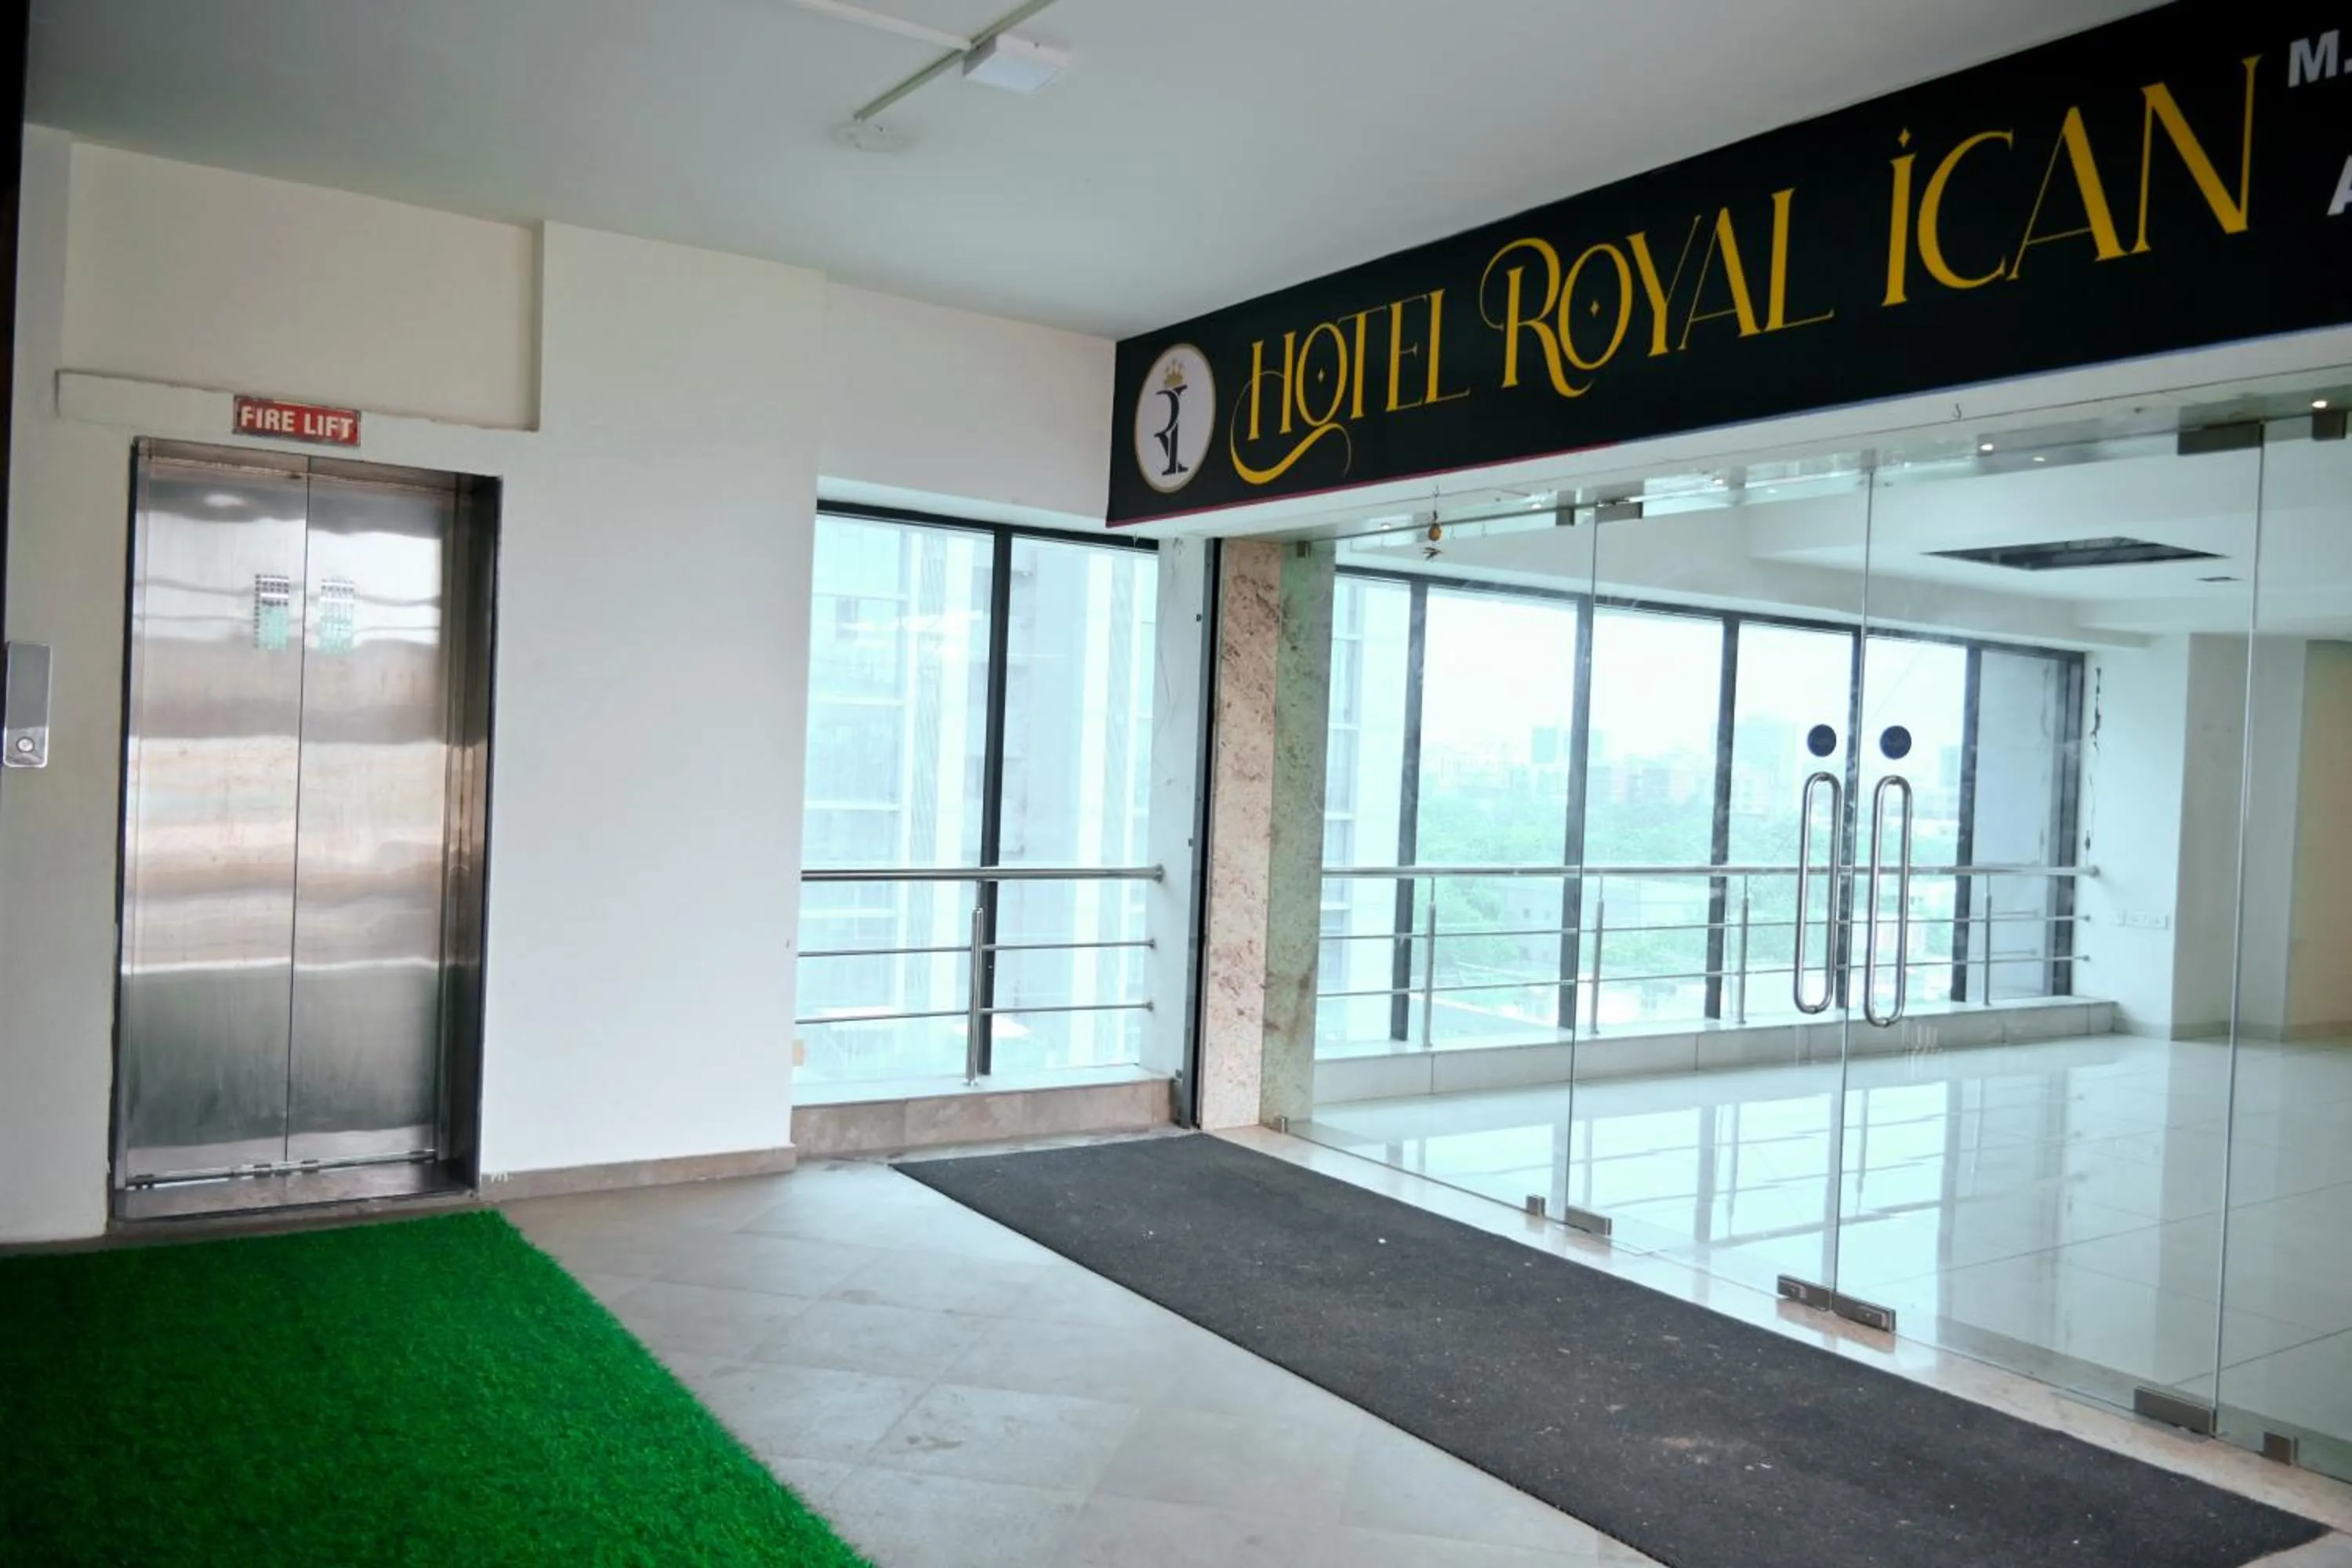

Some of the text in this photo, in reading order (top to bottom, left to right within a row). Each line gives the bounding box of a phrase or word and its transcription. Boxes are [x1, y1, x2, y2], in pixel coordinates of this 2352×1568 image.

[1229, 288, 1471, 485] HOTEL
[1479, 187, 1835, 398] ROYAL
[240, 405, 355, 440] FIRE LIFT
